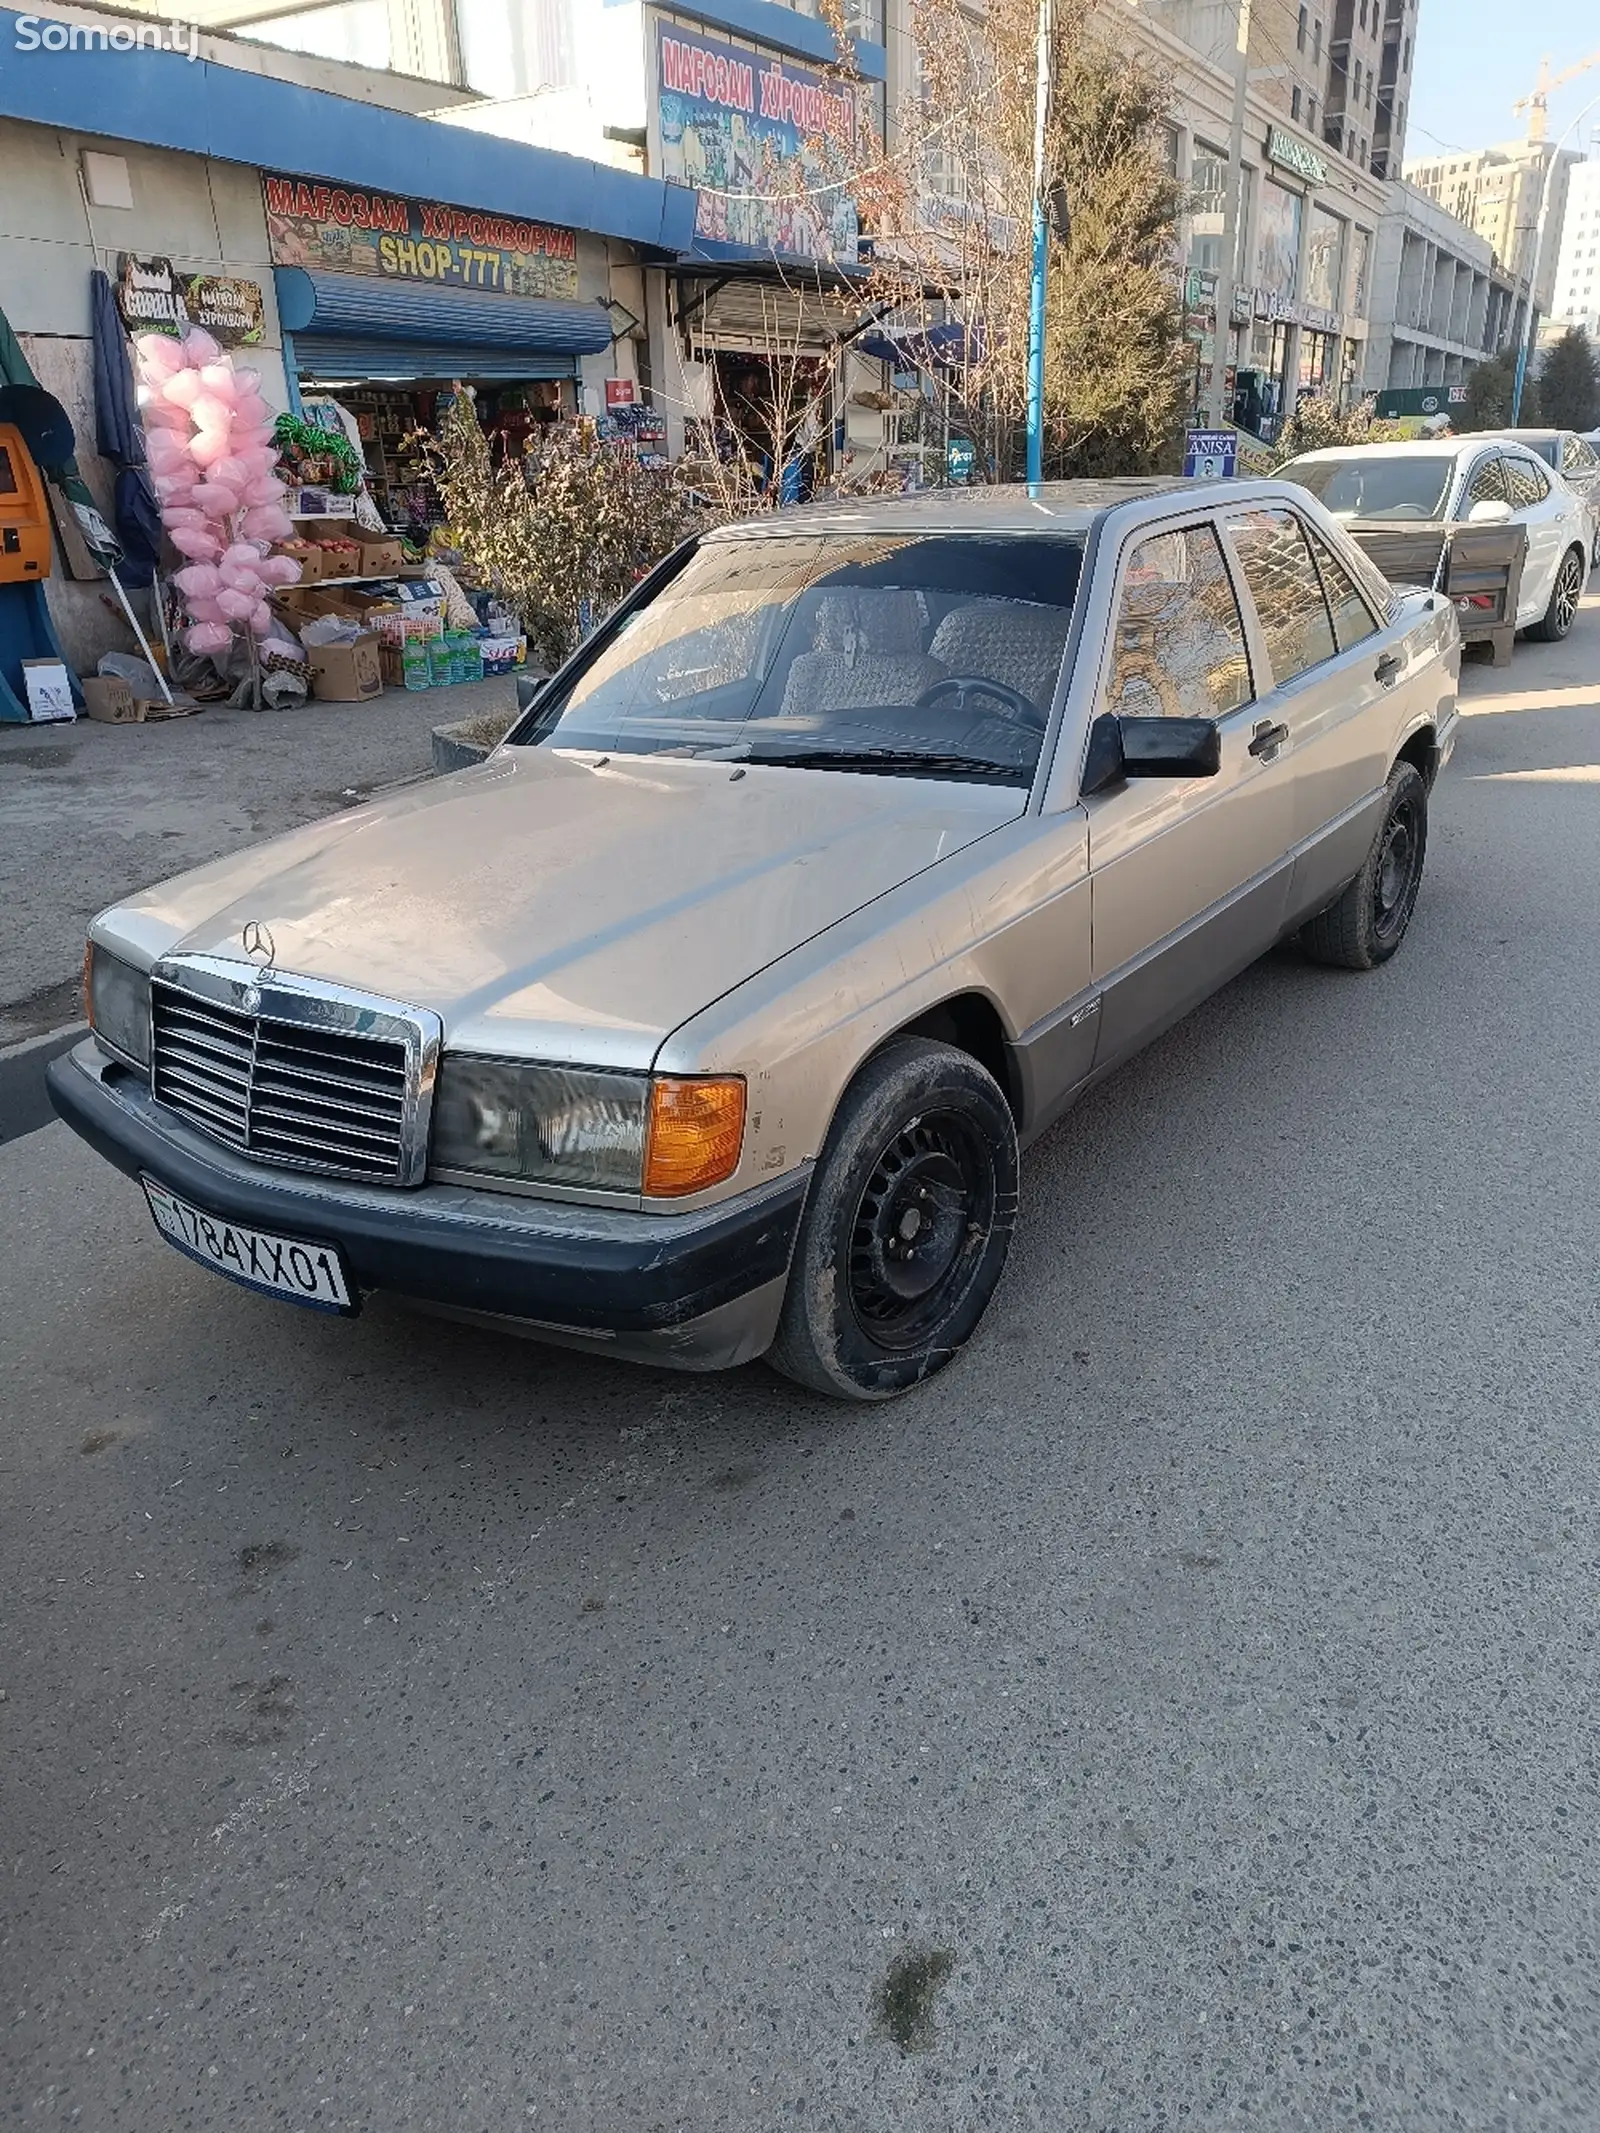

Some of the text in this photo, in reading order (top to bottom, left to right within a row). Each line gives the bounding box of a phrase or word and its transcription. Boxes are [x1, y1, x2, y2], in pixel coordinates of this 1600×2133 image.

[379, 234, 501, 287] SHOP-777
[1189, 441, 1233, 455] ANISA
[172, 1200, 340, 1299] 1784XX01
